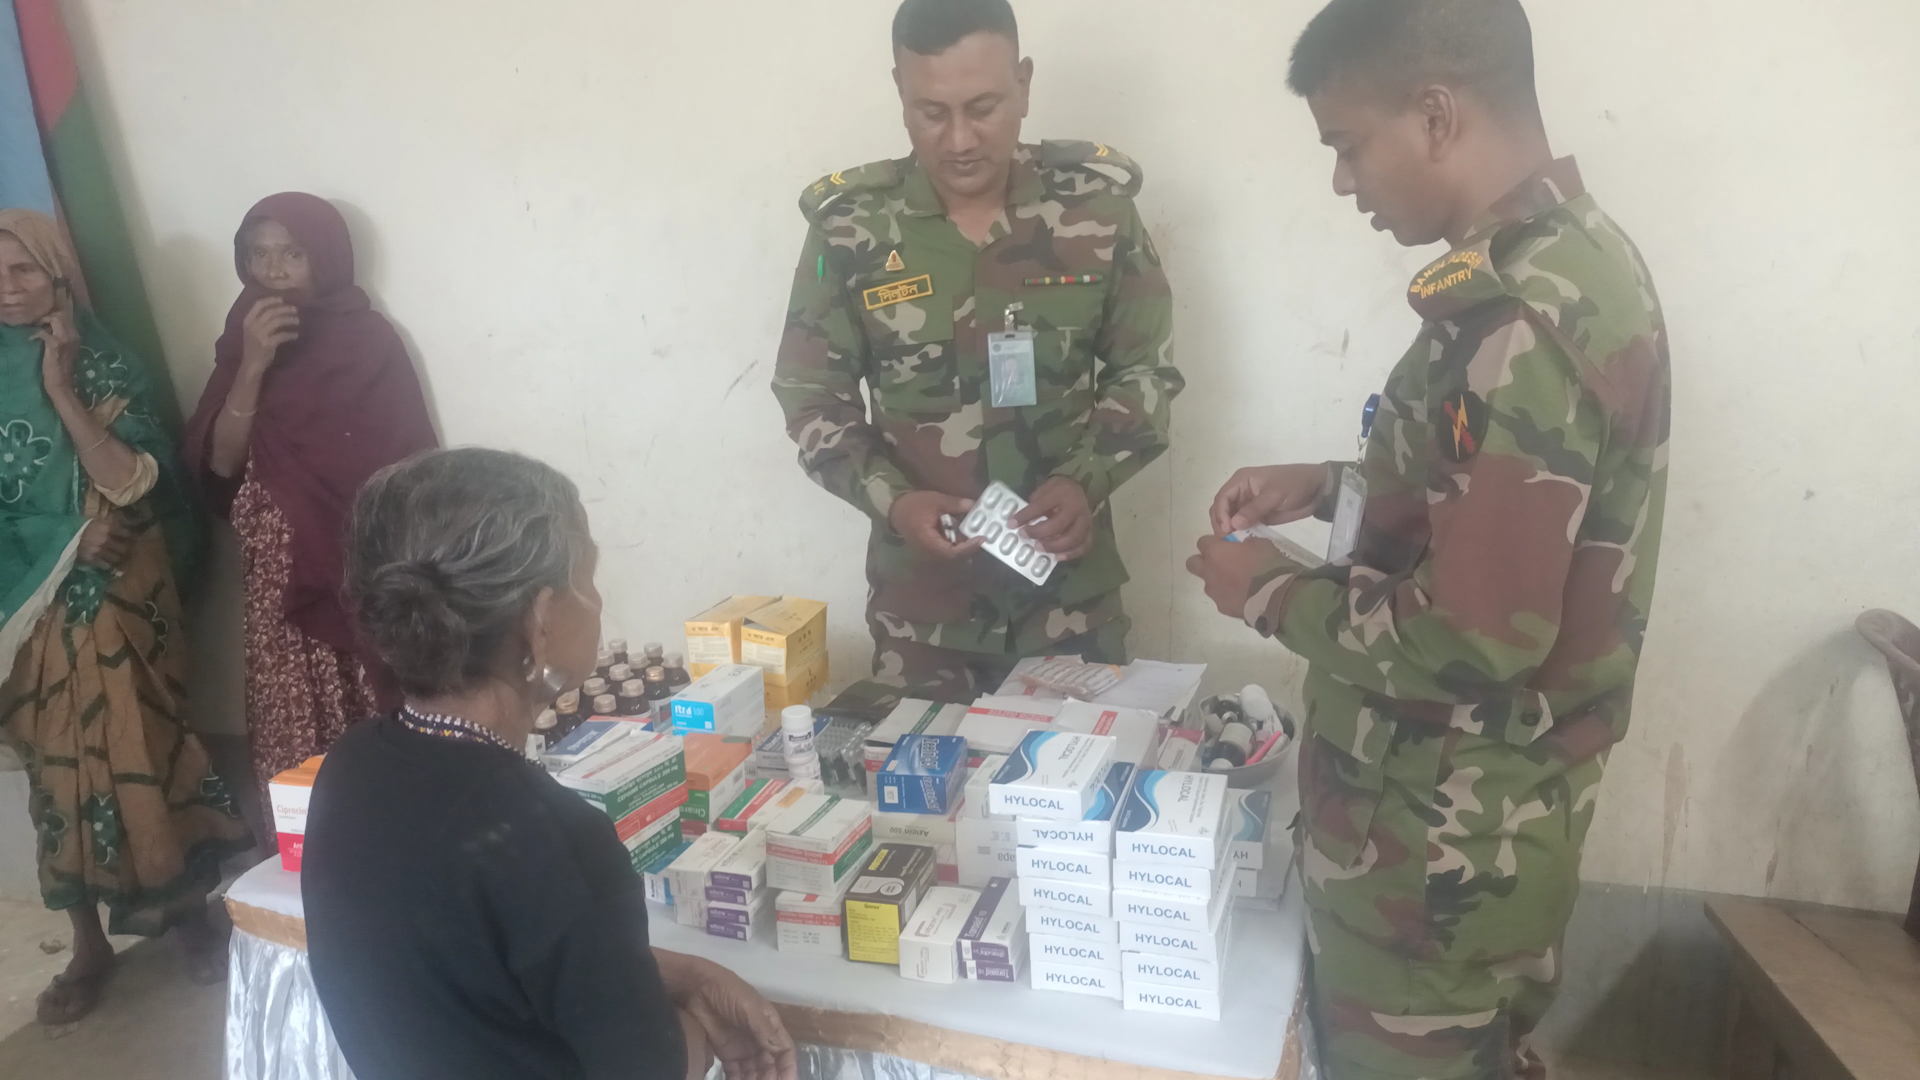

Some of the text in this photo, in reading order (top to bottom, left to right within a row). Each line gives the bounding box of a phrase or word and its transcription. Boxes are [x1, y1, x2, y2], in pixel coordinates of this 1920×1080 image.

[1420, 266, 1472, 299] INFANTRY
[693, 707, 704, 716] 100
[1058, 735, 1082, 761] HYLOCAL
[640, 774, 661, 789] CAPSULE
[671, 764, 678, 772] mg
[1178, 774, 1193, 803] HYLOCAL
[276, 804, 307, 816] Ciprocin
[1004, 794, 1064, 810] HYLOCAL
[904, 828, 930, 838] Azicin
[1032, 828, 1094, 842] HYLOCAL
[1132, 842, 1196, 859] HYLOCAL
[1032, 858, 1092, 874] HYLOCAL
[1129, 870, 1192, 888] HYLOCAL
[1034, 888, 1093, 906] HYLOCAL
[1128, 904, 1191, 922] HYLOCAL
[1040, 916, 1100, 934] HYLOCAL
[1135, 933, 1198, 950] HYLOCAL
[1044, 944, 1104, 960] HYLOCAL
[1046, 972, 1106, 988] HYLOCAL
[1138, 964, 1200, 980] HYLOCAL
[1139, 993, 1202, 1010] HYLOCAL
